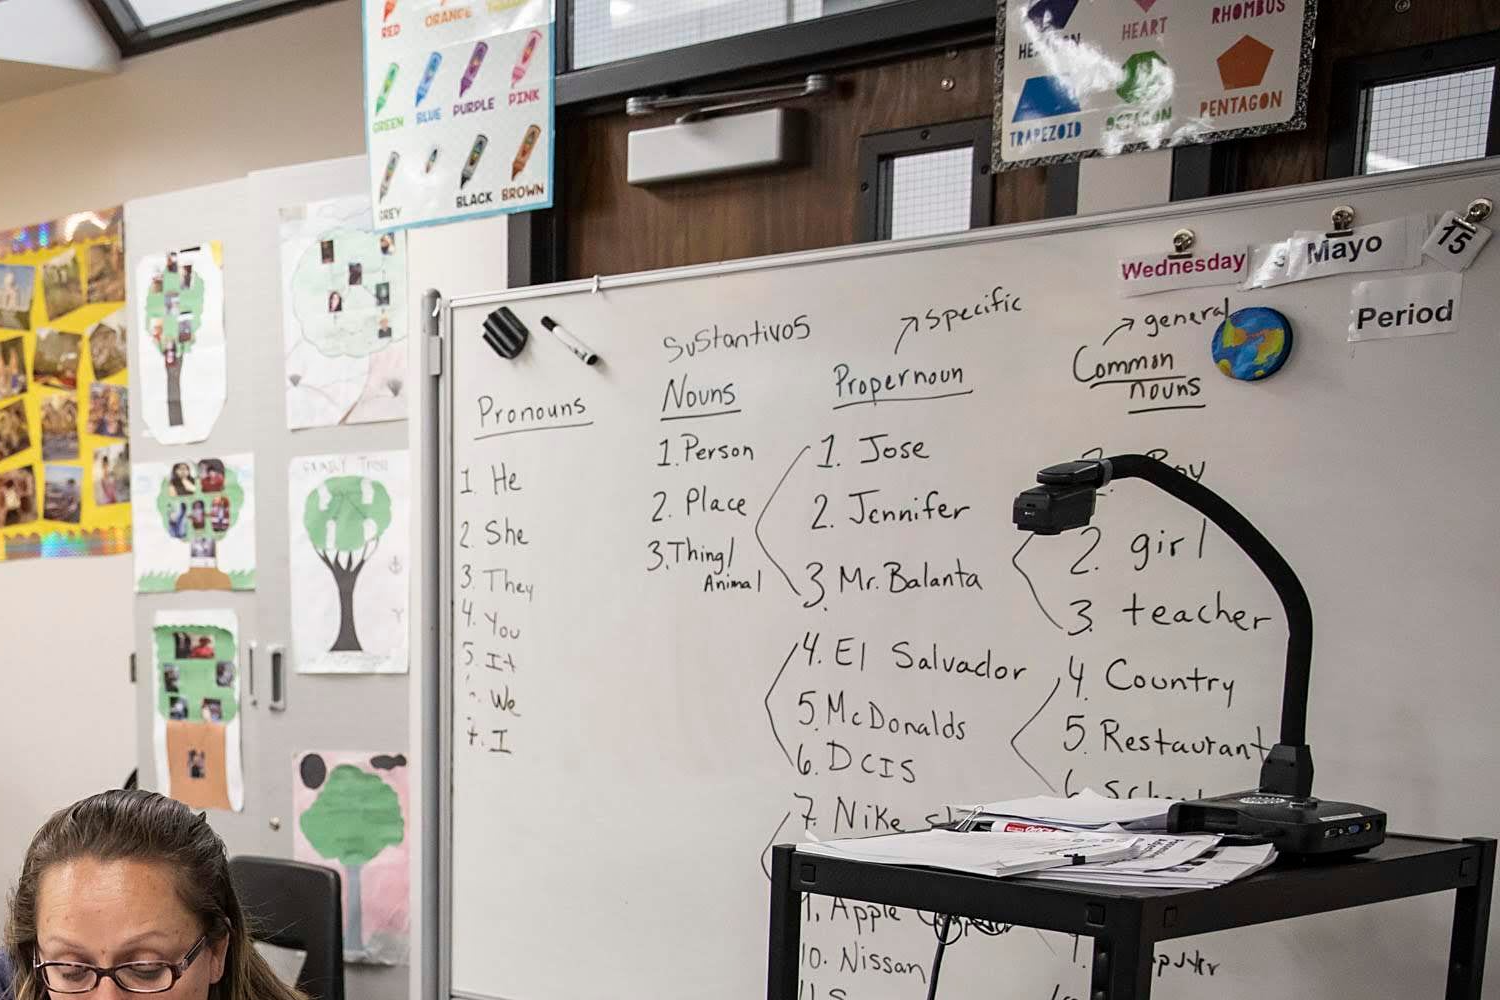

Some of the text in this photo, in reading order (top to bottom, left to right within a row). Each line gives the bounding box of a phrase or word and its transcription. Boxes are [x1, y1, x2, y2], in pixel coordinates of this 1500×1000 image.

[381, 24, 401, 39] RED
[1122, 17, 1168, 41] HEART
[453, 97, 495, 116] PURPLE
[508, 88, 540, 106] PINK
[1200, 91, 1283, 118] PENTAGON
[372, 116, 405, 132] GREEN
[416, 108, 442, 125] BLUE
[1010, 122, 1082, 148] TRAPEZOID
[456, 192, 493, 208] BLACK
[501, 184, 544, 201] BROWN
[1306, 234, 1382, 266] Mayo
[1436, 223, 1473, 256] 15
[1121, 252, 1246, 281] Wednesday
[925, 286, 1022, 332] specific
[1144, 297, 1230, 337] general
[1356, 299, 1454, 330] Period
[664, 315, 812, 363] Sustantivos
[1072, 344, 1174, 384] Common
[661, 373, 737, 412] Nouns
[1128, 376, 1202, 399] nouns
[477, 395, 586, 429] Pronouns
[817, 433, 930, 468] 1. Jose
[491, 462, 522, 495] He
[686, 485, 747, 517] Place
[811, 489, 971, 530] 2. Jennifer
[485, 517, 529, 546] She
[1069, 517, 1208, 575] 2. girl
[482, 567, 533, 602] They
[704, 570, 761, 593] Animal
[803, 562, 828, 612] 3.
[484, 610, 521, 640] You
[1067, 590, 1272, 637] 3. teacher
[485, 651, 516, 673] It
[802, 631, 1028, 681] 4. El Salvador
[1068, 655, 1235, 709] 4. Country
[490, 685, 521, 717] We
[489, 729, 512, 754] I
[1063, 714, 1272, 763] 5. Restaurant
[796, 744, 819, 776] 6.
[794, 792, 818, 828] 7.
[834, 795, 905, 833] Nike
[831, 895, 902, 935] Apple
[839, 941, 926, 985] Nissan
